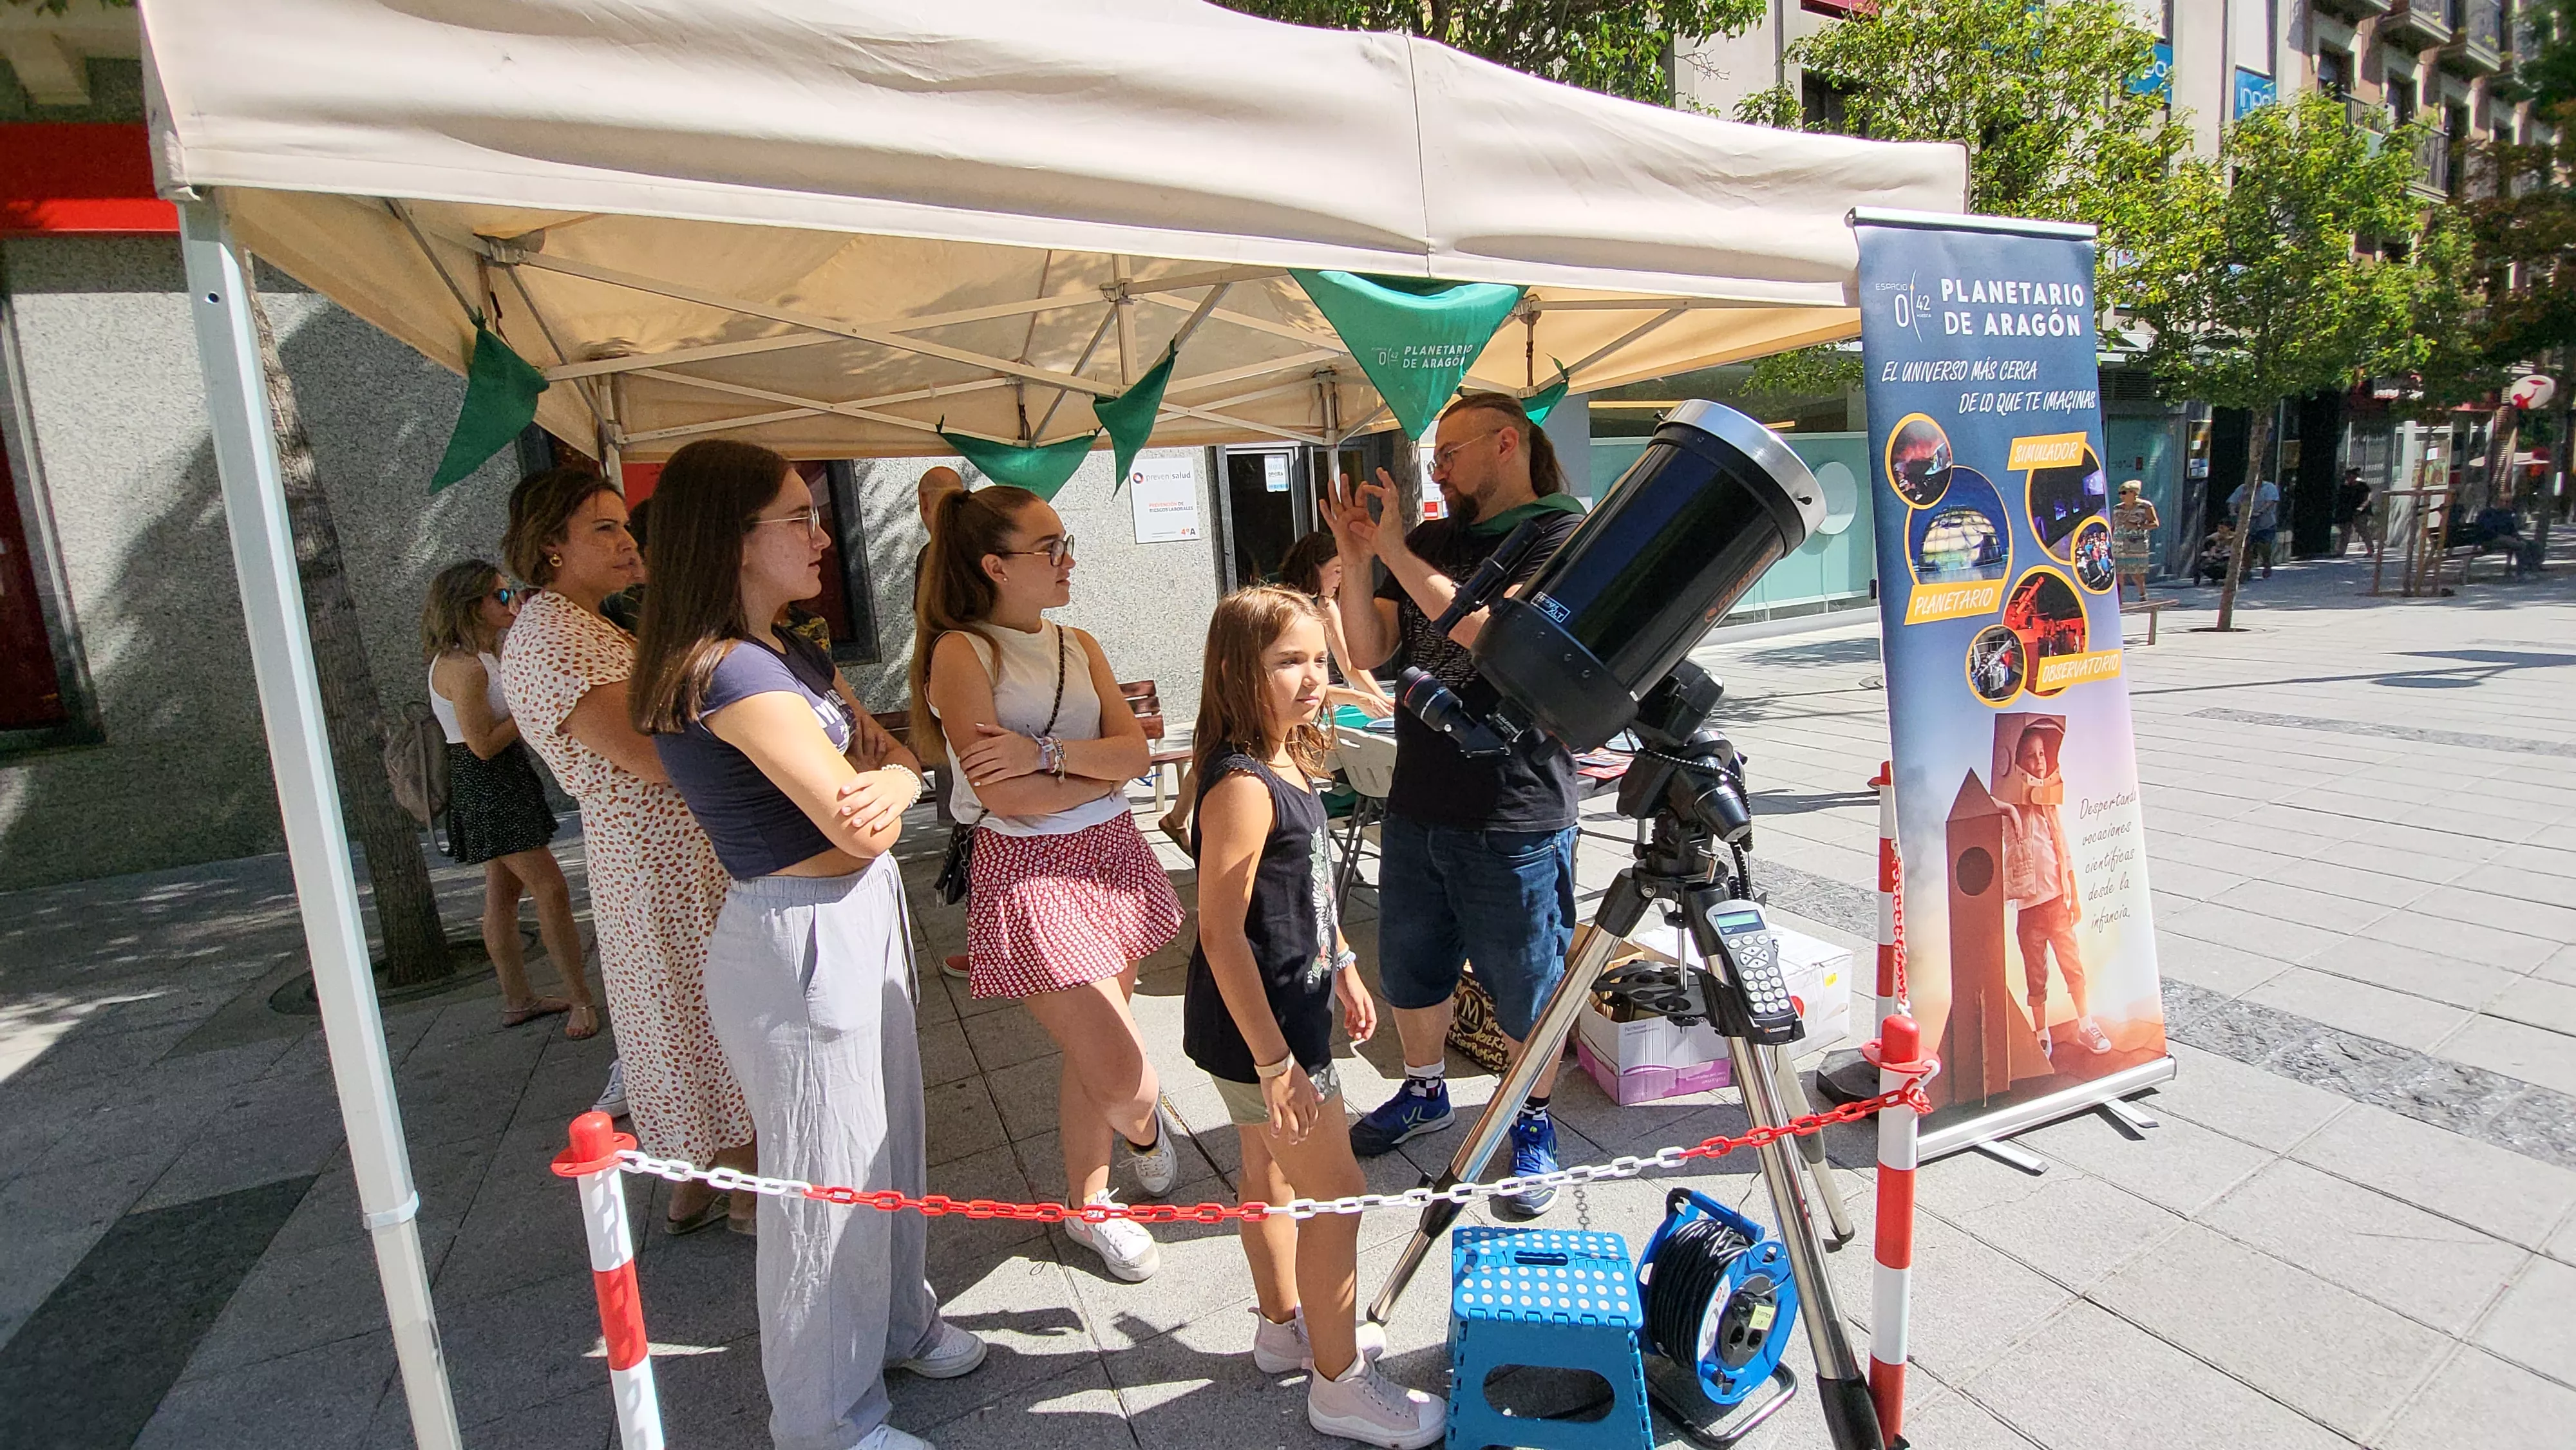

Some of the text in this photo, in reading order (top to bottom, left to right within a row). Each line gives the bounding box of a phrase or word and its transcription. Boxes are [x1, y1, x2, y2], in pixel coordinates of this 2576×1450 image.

[1875, 283, 1908, 291] ESPACIO
[1940, 278, 2085, 307] PLANETARIO
[1944, 307, 2081, 337] DE ARAGÓN
[1404, 344, 1473, 355] PLANETARIO
[1403, 359, 1417, 368] DE
[1881, 356, 2038, 382] EL UNIVERSO MÁS CERCA
[1958, 390, 2096, 416] DE LO QUE TE IMAGINAS
[2014, 442, 2078, 464] SIMULADOR
[1171, 471, 1191, 479] salud
[1914, 587, 1994, 616] PLANETARIO
[2042, 654, 2118, 683] OBSERVATORIO
[2082, 821, 2132, 845] vocaciones
[2088, 871, 2130, 901] desde la
